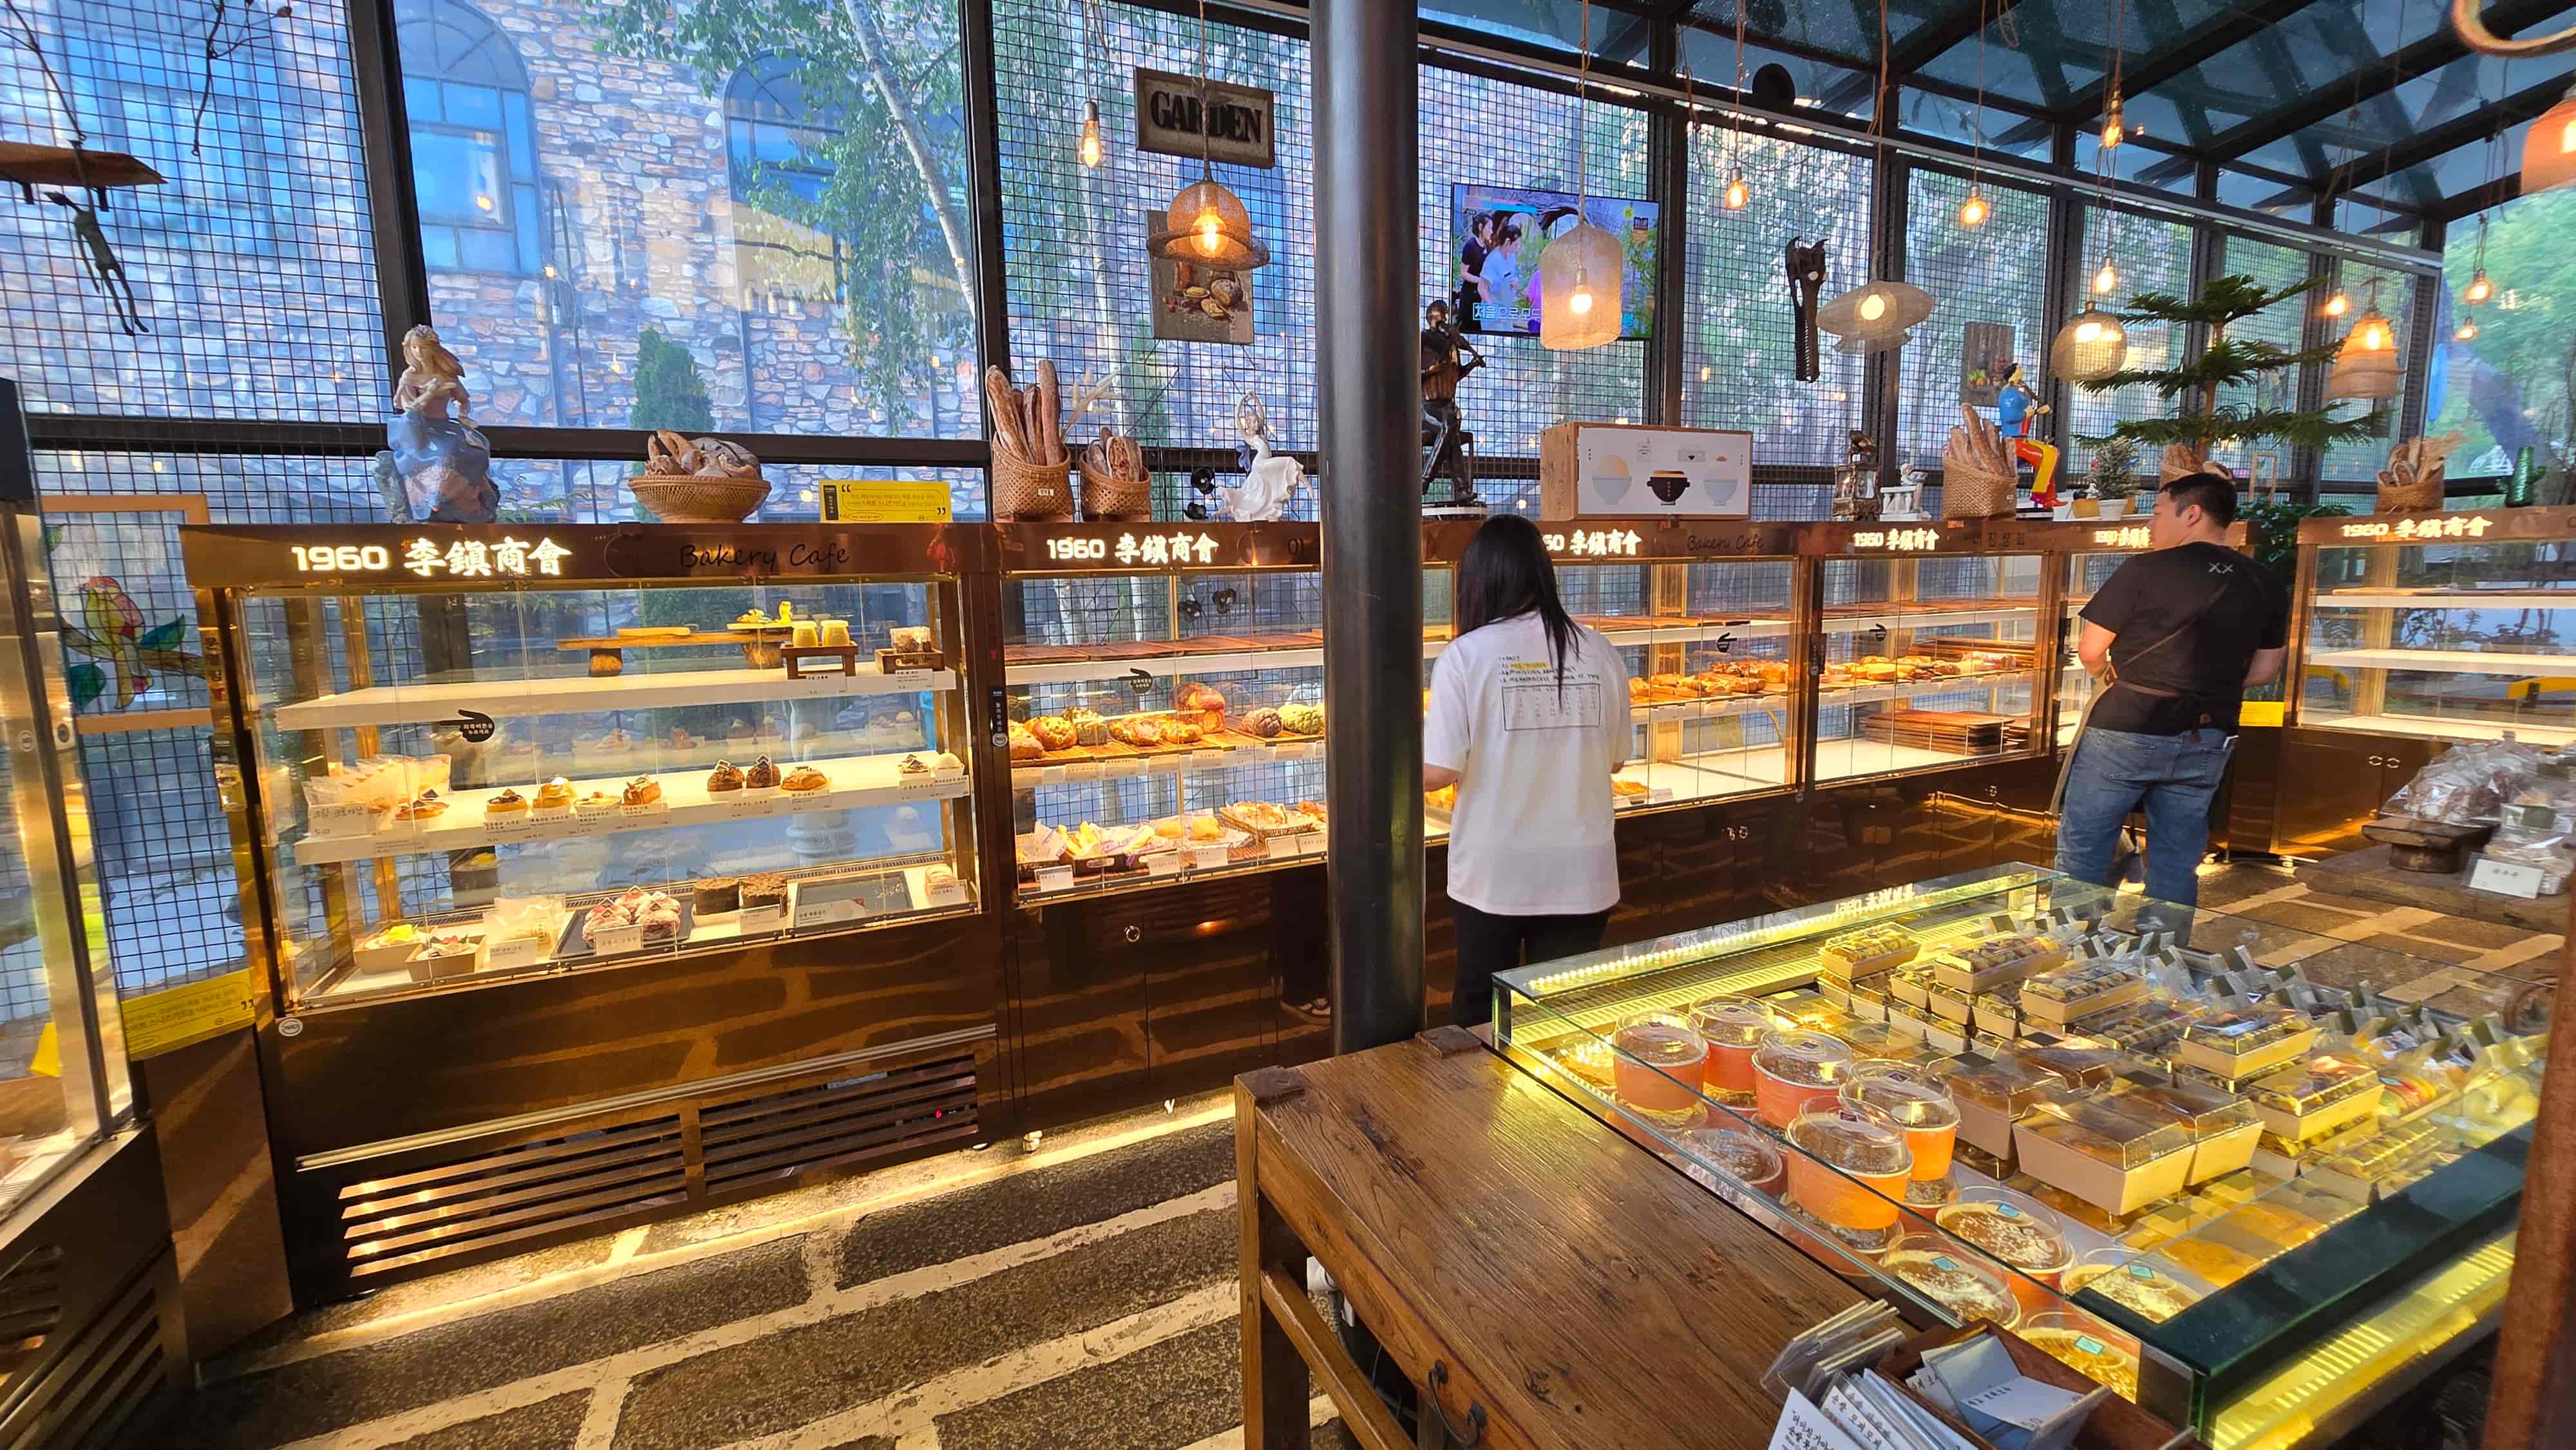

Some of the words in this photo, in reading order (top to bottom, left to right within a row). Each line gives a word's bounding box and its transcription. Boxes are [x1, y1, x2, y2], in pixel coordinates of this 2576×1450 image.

[1150, 90, 1262, 143] GARDEN
[290, 545, 389, 572] 1960
[680, 544, 777, 572] Bakery
[790, 543, 849, 570] Cafe
[1046, 538, 1106, 560] 1960
